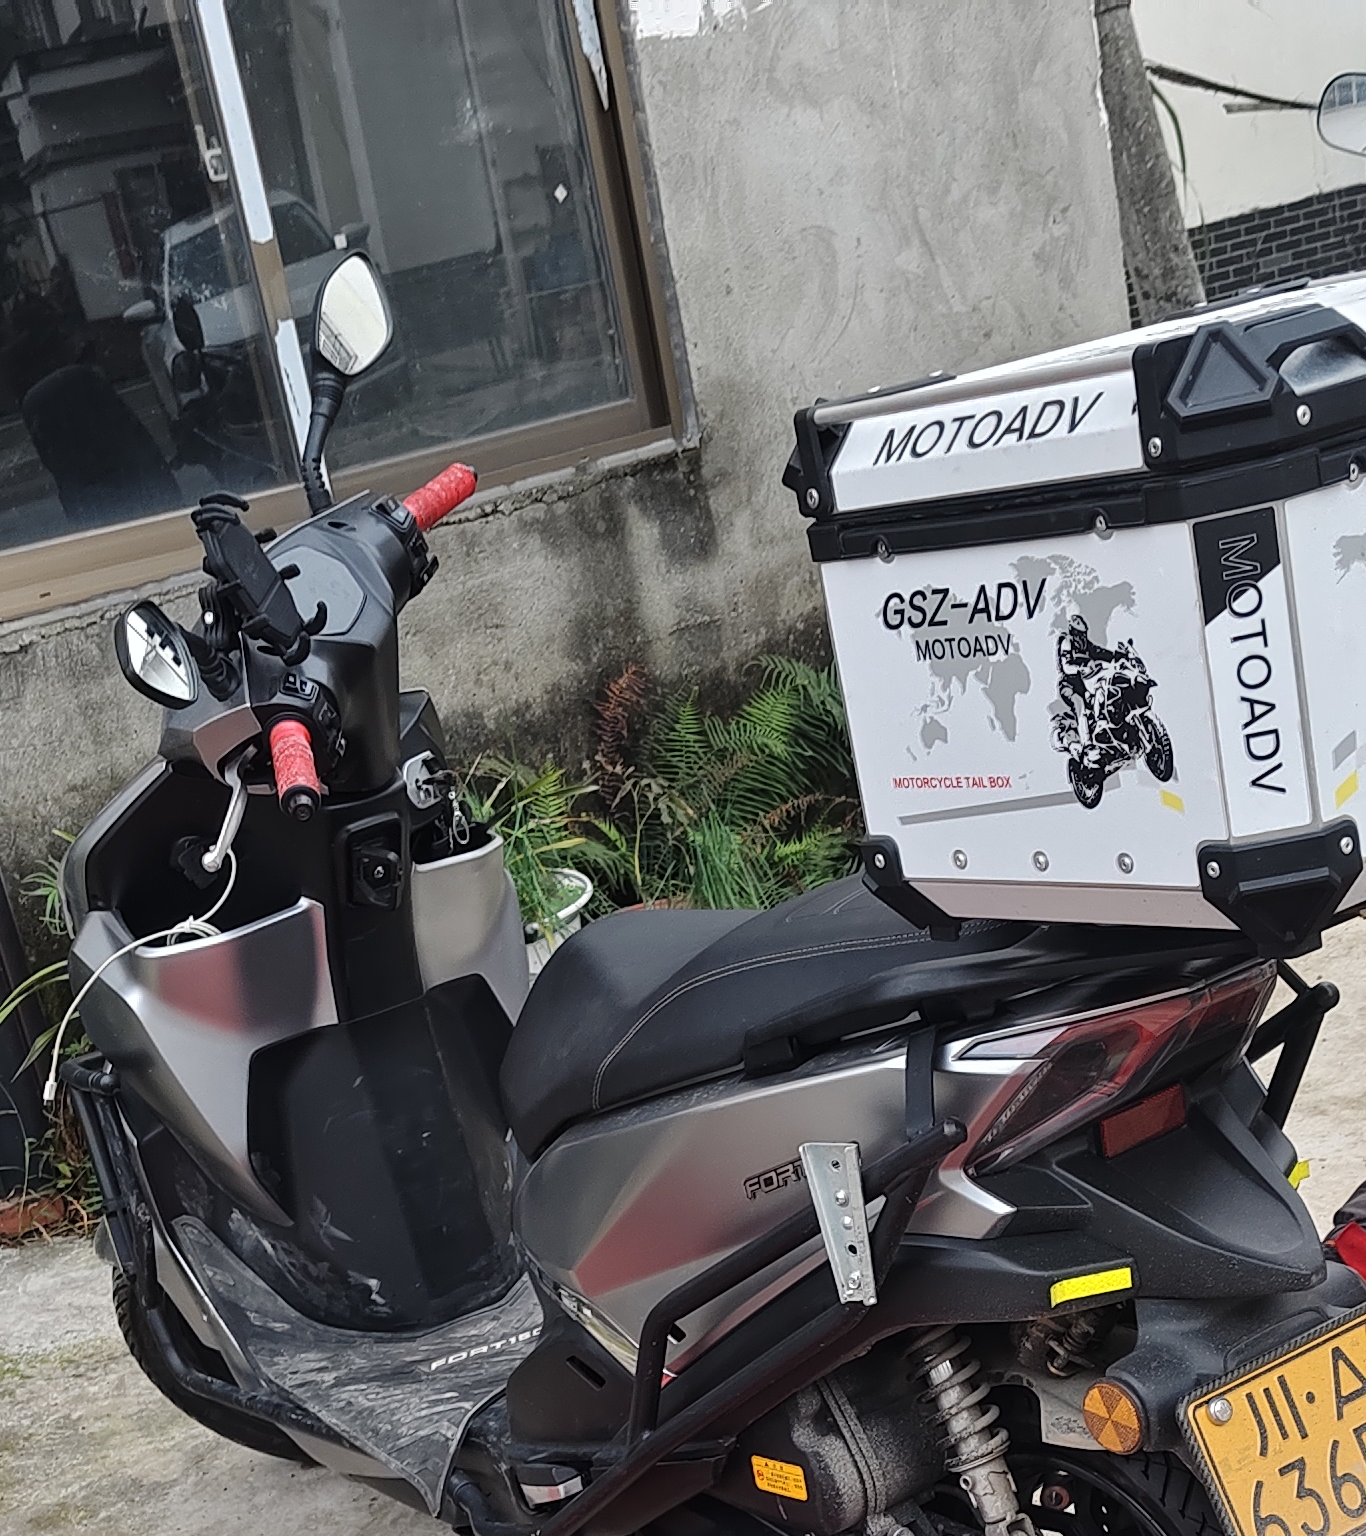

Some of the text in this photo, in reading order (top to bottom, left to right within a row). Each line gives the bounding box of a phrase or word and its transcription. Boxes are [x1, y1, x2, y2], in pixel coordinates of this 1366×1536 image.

[873, 391, 1105, 466] MOTOADV
[882, 578, 1046, 630] GSZ-ADV
[915, 633, 1012, 662] MOTOADV
[1218, 533, 1287, 794] MOTOADV
[893, 776, 1012, 789] MOTORCYCLE TAIL BOX
